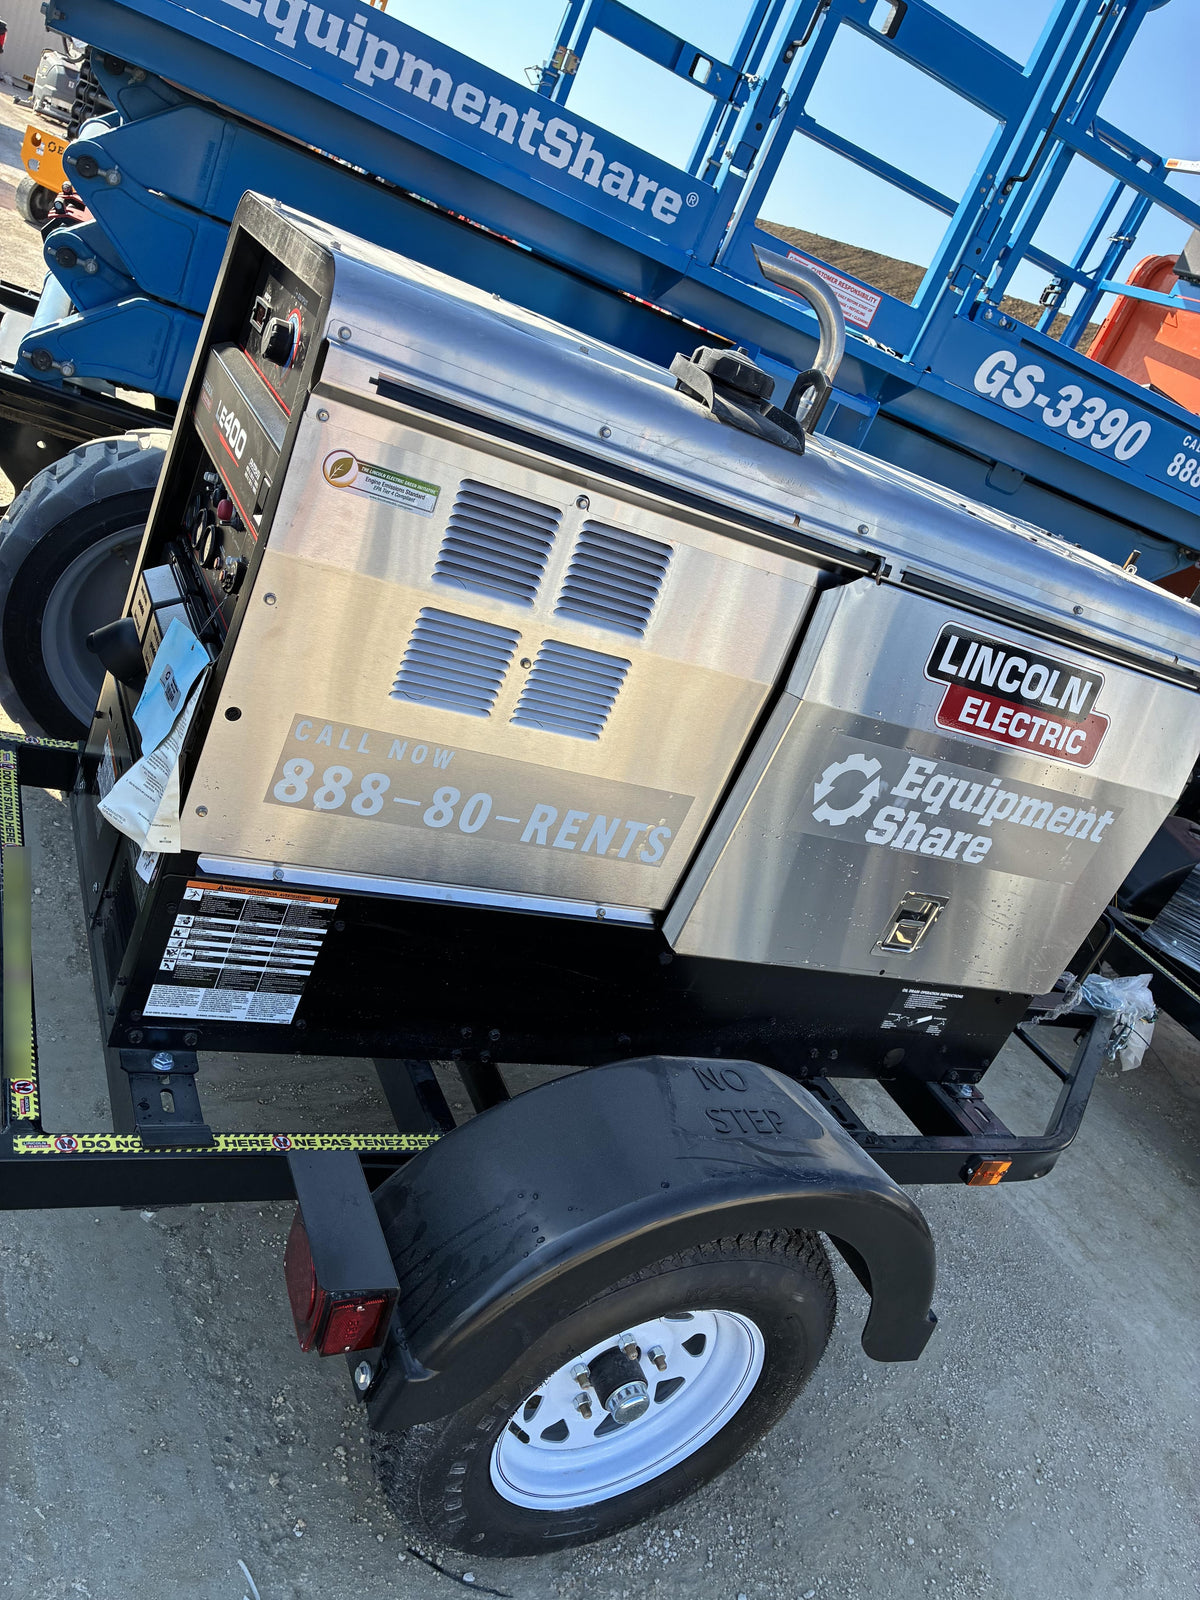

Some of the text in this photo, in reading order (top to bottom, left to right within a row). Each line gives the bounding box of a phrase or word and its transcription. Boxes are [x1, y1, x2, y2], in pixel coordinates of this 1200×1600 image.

[838, 279, 878, 304] RESPONSIBILITY
[974, 350, 1152, 461] GS-3390
[364, 476, 425, 499] Engine Emissions Standard
[394, 492, 415, 502] Compliant
[938, 636, 1093, 714] LINCOLN
[958, 696, 1087, 755] ELECTRIC
[294, 720, 456, 769] CALL NOW
[3, 770, 11, 780] DO
[3, 782, 12, 796] NOT
[891, 756, 1115, 843] Equipment
[4, 797, 14, 820] STAND
[273, 758, 672, 863] 888-80-RENTS
[6, 822, 15, 843] HERE
[865, 805, 992, 864] Share
[691, 1066, 749, 1092] NO
[705, 1108, 785, 1134] STEP
[82, 1140, 142, 1149] DO NO
[224, 1139, 271, 1148] HERE
[294, 1138, 318, 1147] NE
[319, 1138, 353, 1147] PAS
[352, 1138, 405, 1147] TENEZ
